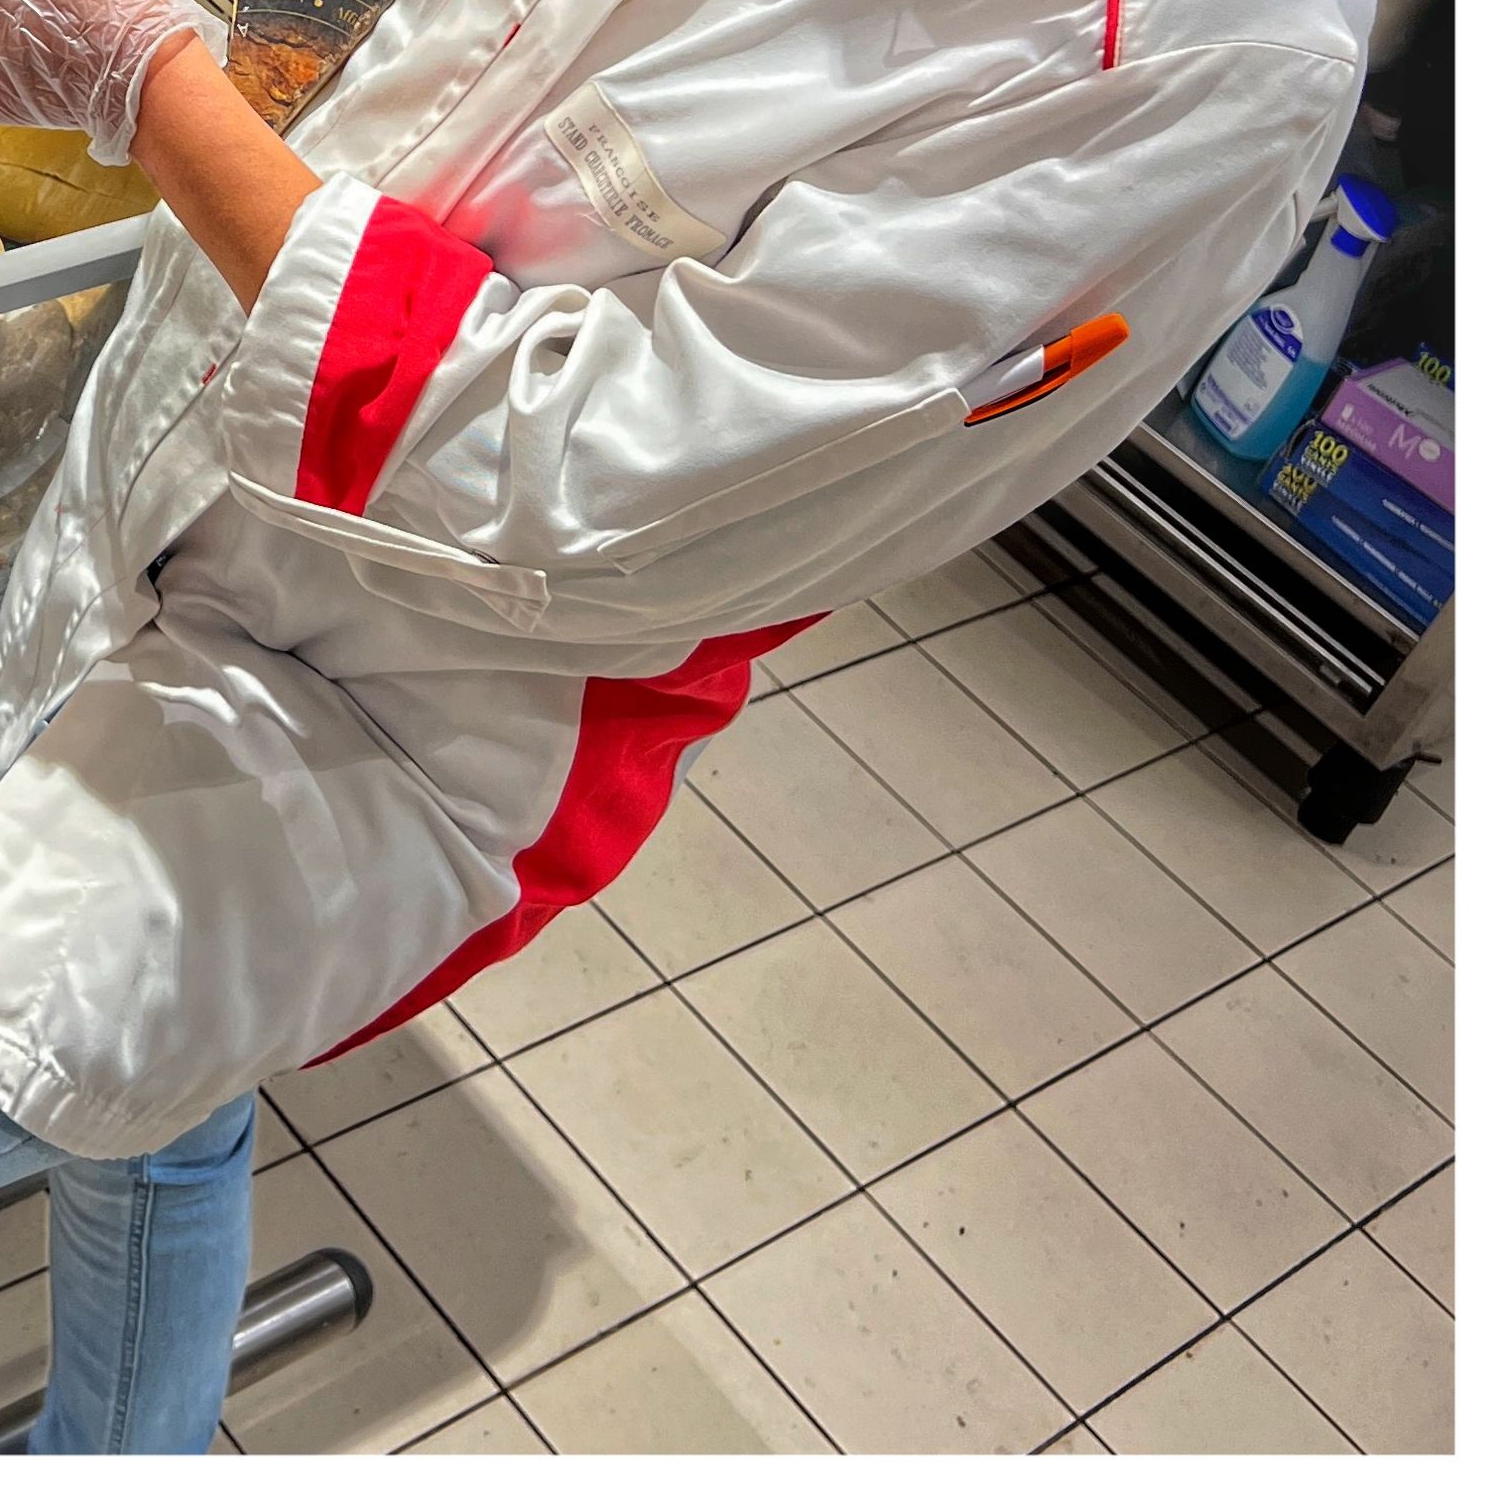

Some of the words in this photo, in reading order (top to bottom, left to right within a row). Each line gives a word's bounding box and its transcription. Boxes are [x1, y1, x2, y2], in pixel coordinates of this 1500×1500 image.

[557, 116, 589, 152] STAND
[624, 214, 675, 250] FROMAGE
[1310, 430, 1348, 466] 100
